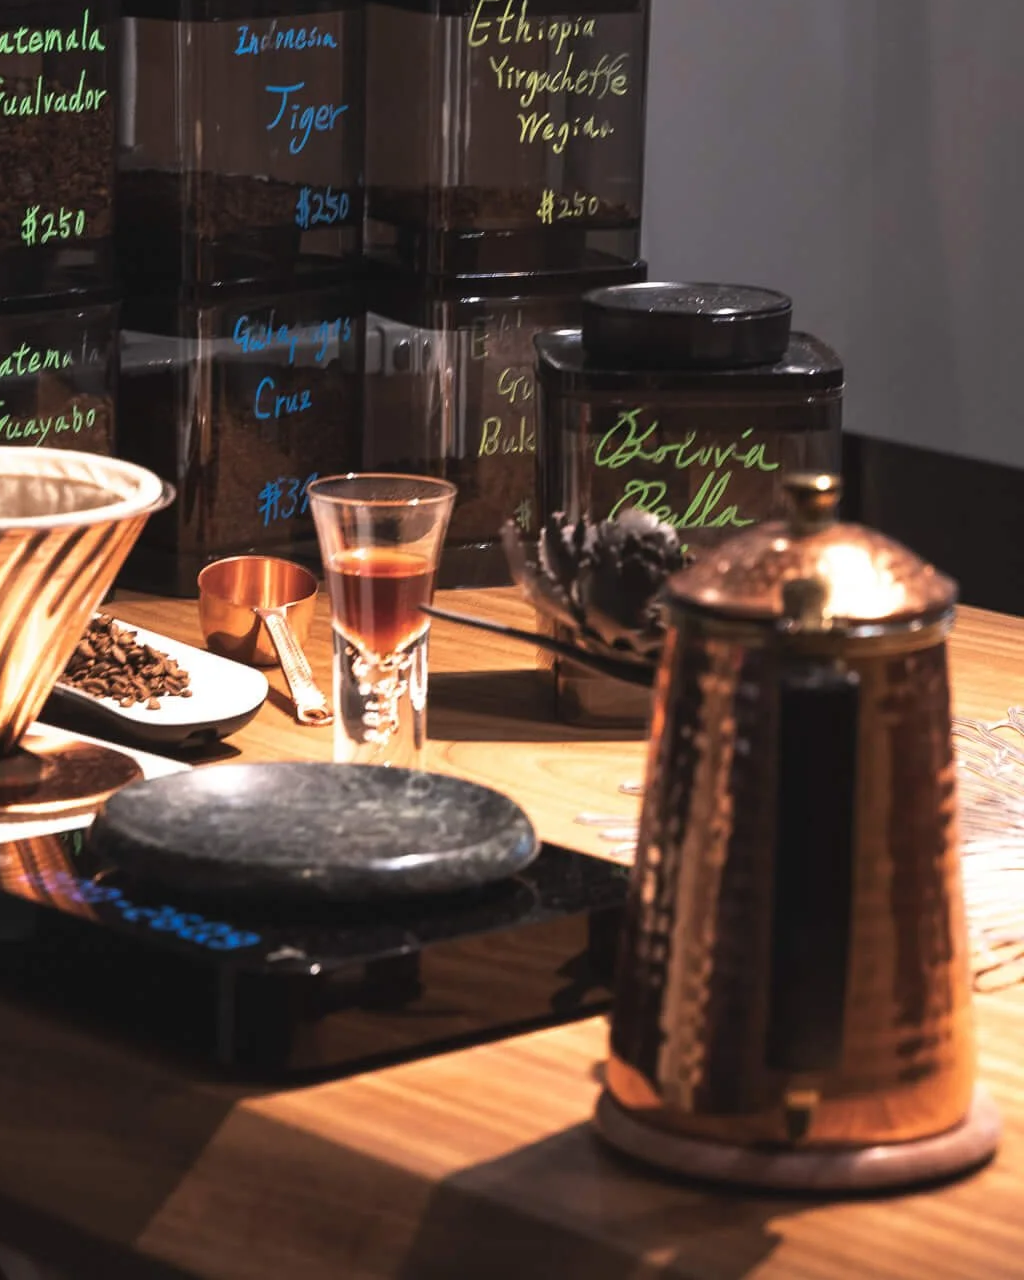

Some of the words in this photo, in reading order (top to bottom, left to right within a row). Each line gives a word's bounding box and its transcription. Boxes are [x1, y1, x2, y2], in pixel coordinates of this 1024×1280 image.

[265, 82, 349, 154] Tiger
[21, 205, 85, 246] $250
[294, 185, 350, 228] $250
[536, 188, 599, 224] $250
[254, 376, 312, 419] Cruz
